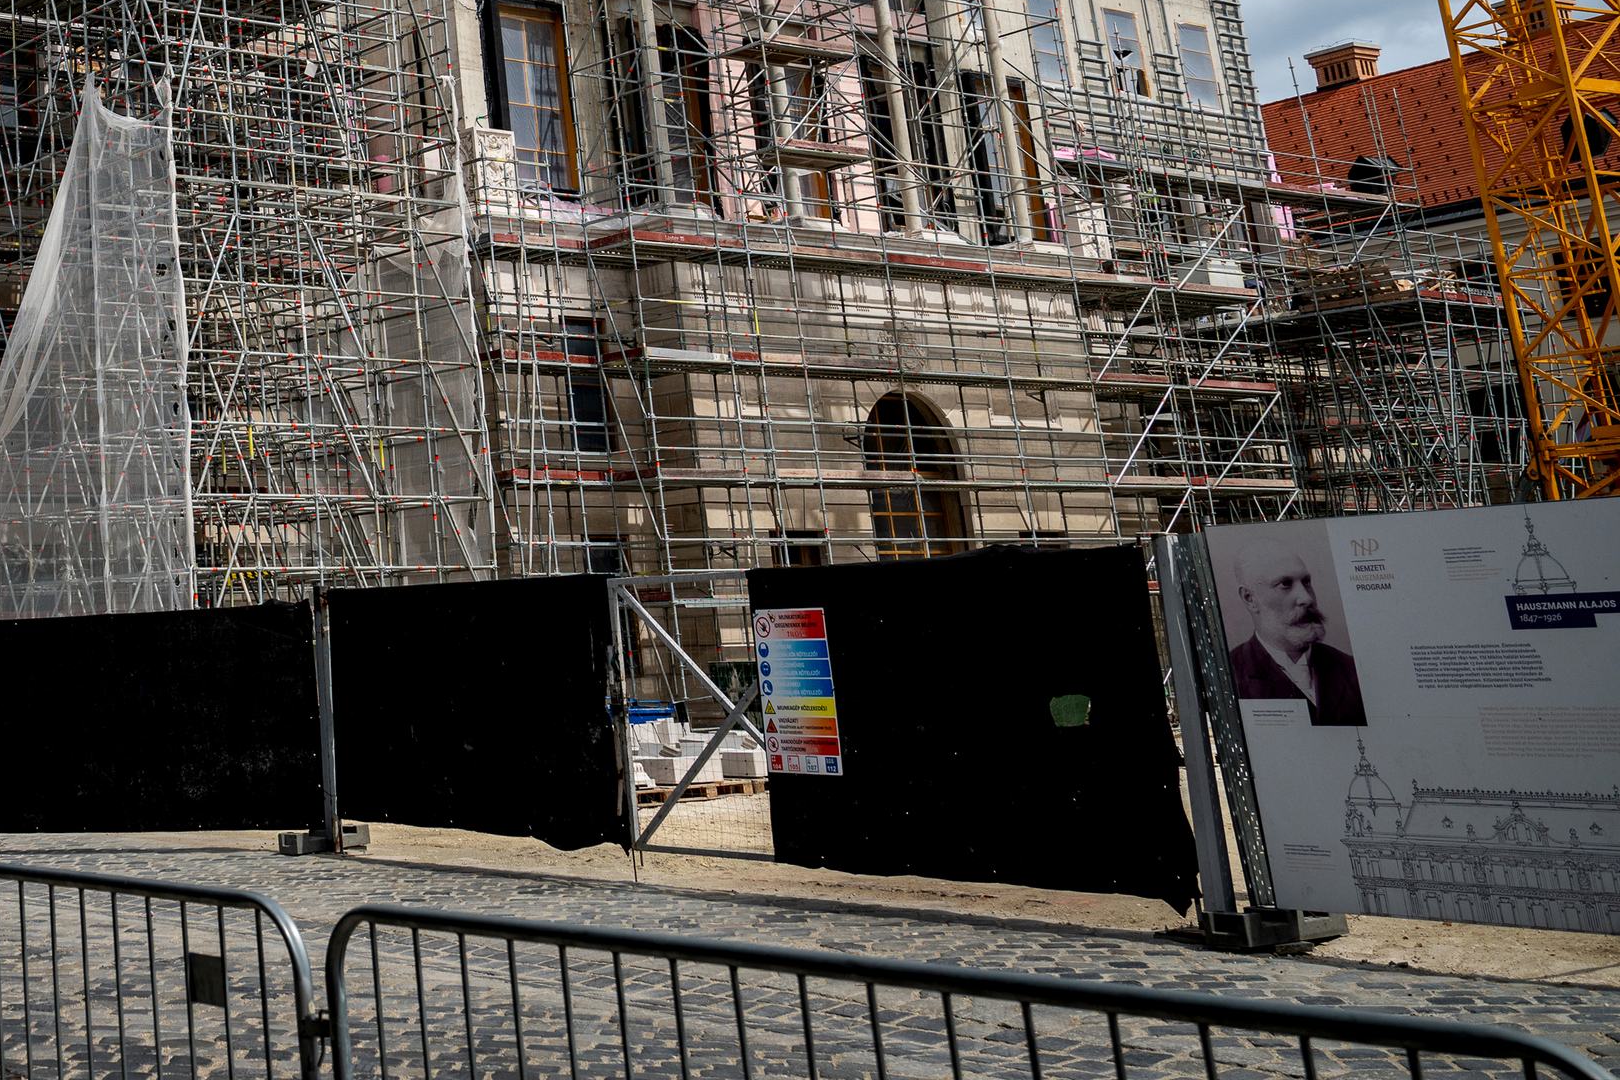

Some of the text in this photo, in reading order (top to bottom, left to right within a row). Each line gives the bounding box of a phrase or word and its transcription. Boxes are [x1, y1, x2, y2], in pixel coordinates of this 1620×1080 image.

[1354, 564, 1386, 572] NEMZETI
[1350, 573, 1394, 582] HAUSZMANN
[1356, 582, 1392, 591] PROGRAM
[1516, 600, 1617, 612] HAUSZMANN ALAJOS
